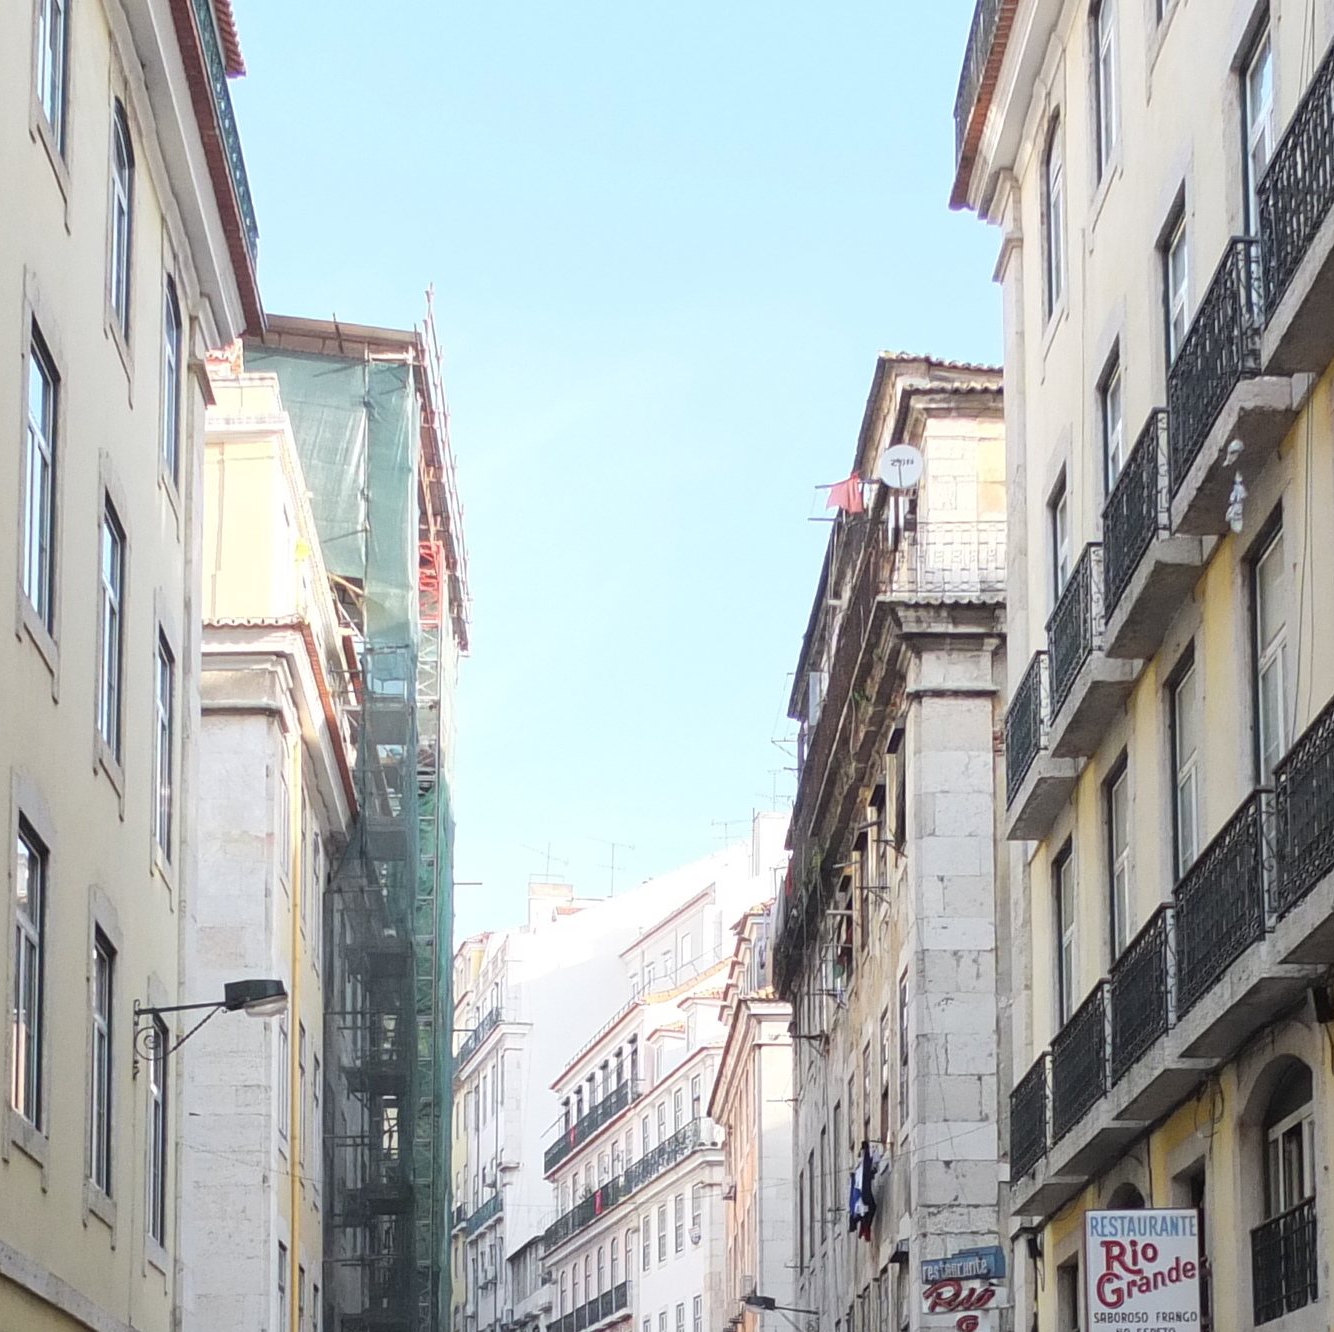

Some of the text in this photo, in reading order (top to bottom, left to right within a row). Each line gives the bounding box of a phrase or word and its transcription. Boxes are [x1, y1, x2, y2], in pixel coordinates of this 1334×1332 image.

[1090, 1215, 1197, 1237] RESTAURANTE
[1100, 1239, 1159, 1276] Rio
[922, 1279, 996, 1313] Rio
[1097, 1256, 1196, 1309] Grande
[1094, 1311, 1198, 1324] SABOROSO FRANGO
